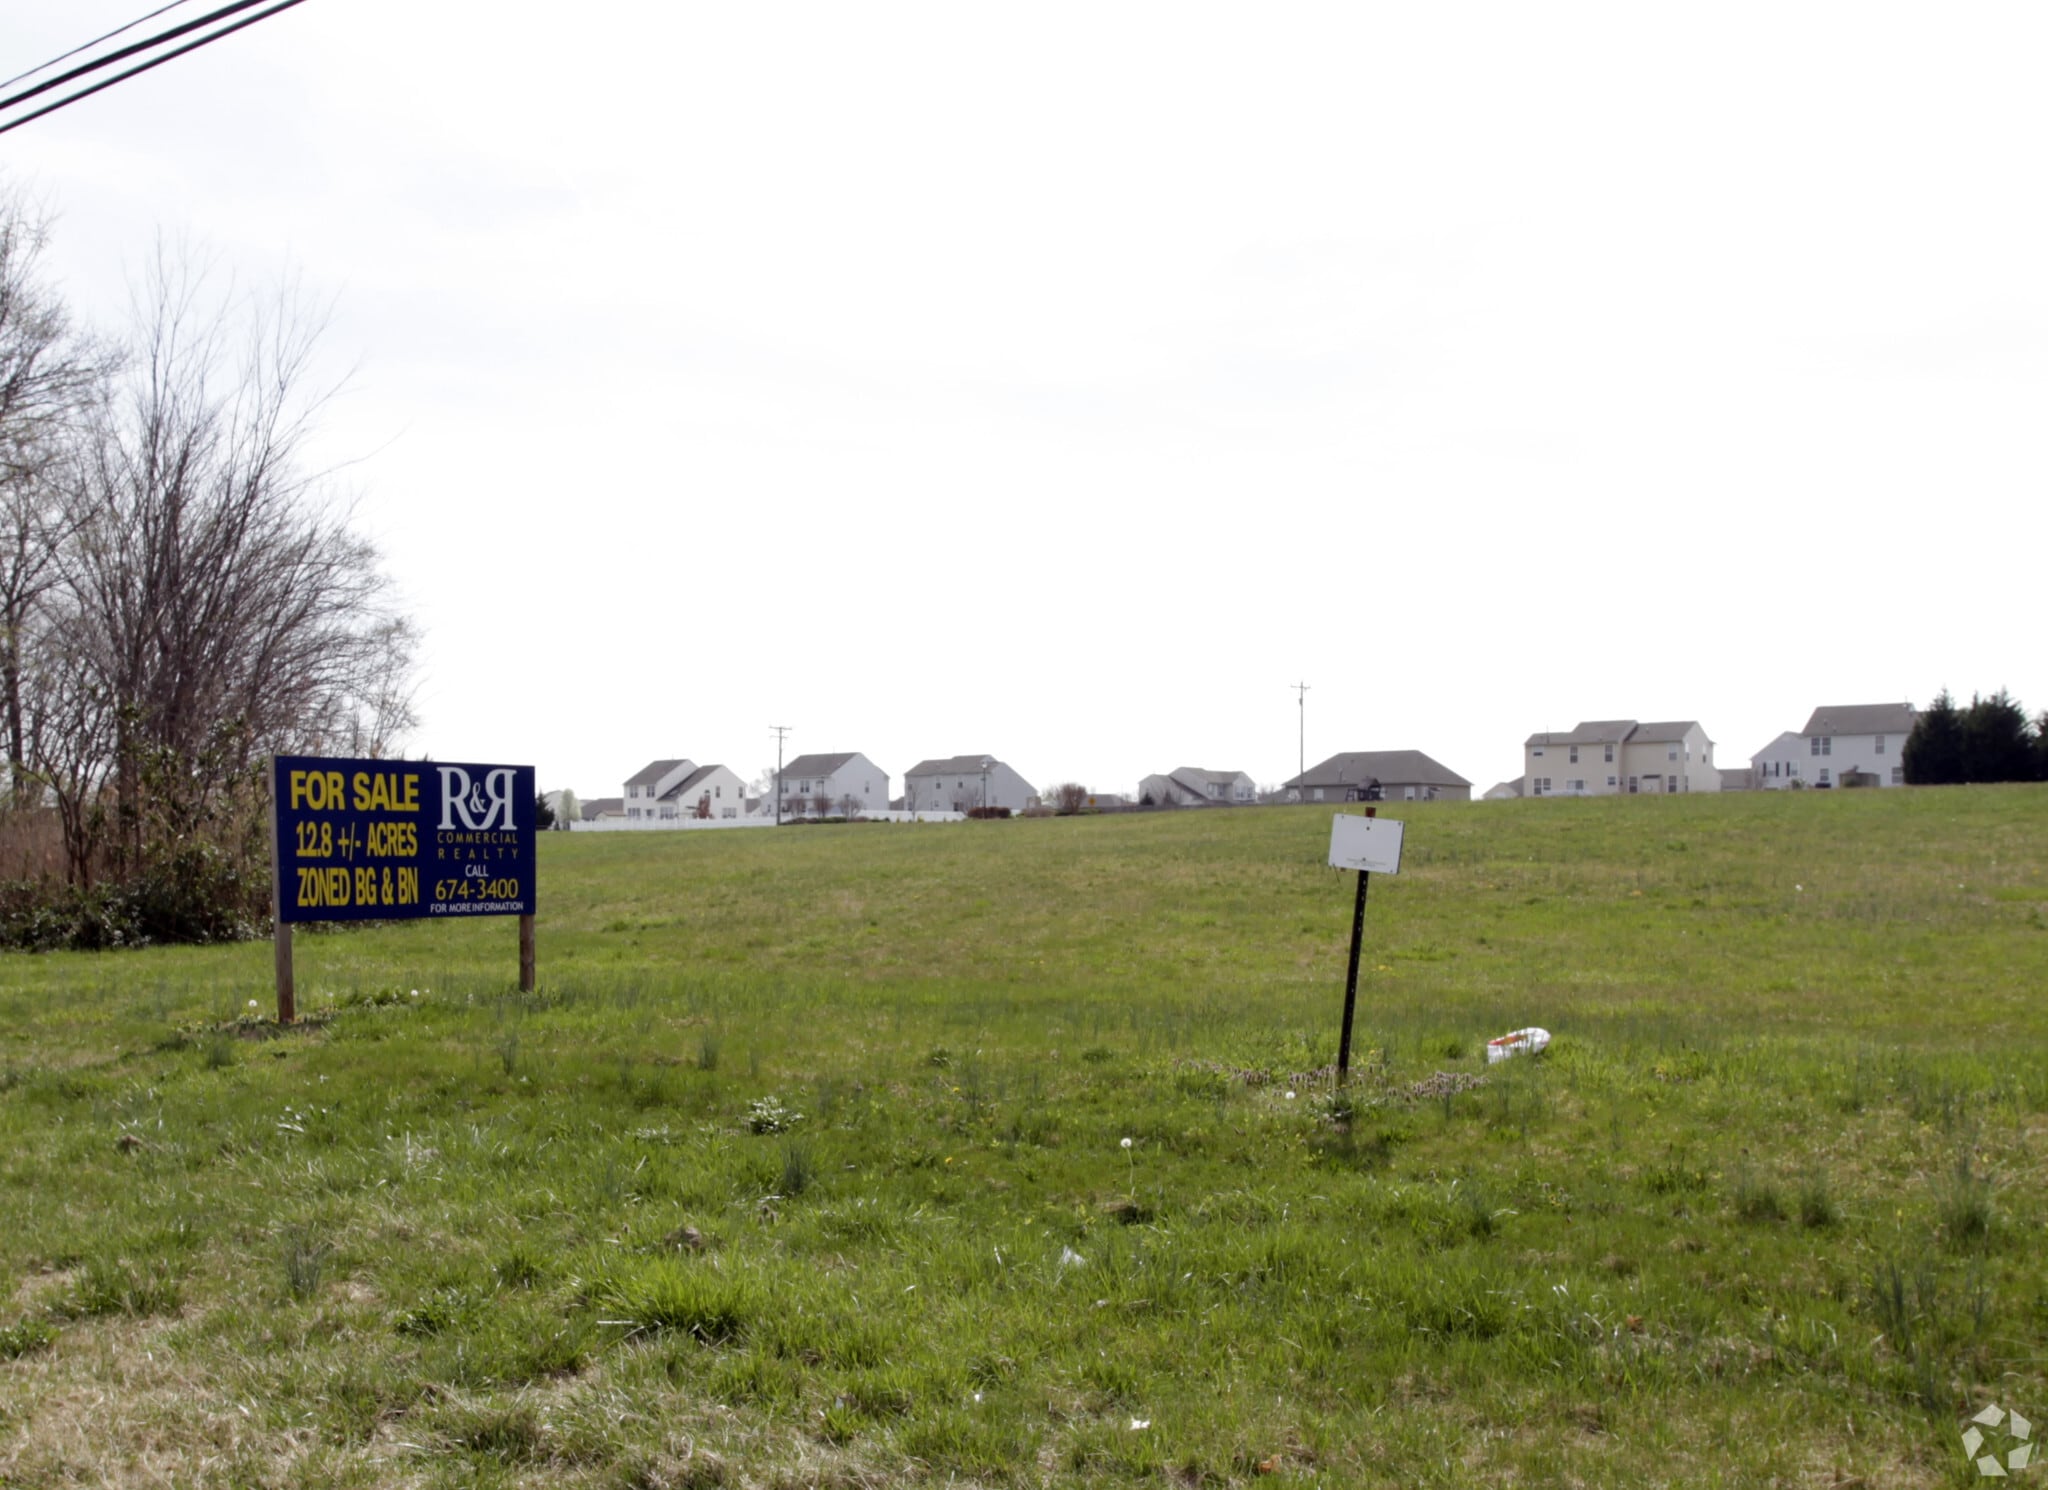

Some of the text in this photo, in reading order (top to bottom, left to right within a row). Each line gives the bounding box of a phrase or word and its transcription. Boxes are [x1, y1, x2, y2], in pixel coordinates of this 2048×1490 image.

[290, 771, 419, 812] FOR SALE
[296, 821, 417, 861] 12.8 +/- ACRES
[437, 832, 518, 844] COMMERCIAL
[438, 847, 519, 860] REALTY
[465, 864, 488, 878] CALL
[297, 866, 418, 907] ZONED BG & BN
[435, 879, 518, 900] 674-3400
[430, 901, 523, 913] FOR MORE INFORMATION
